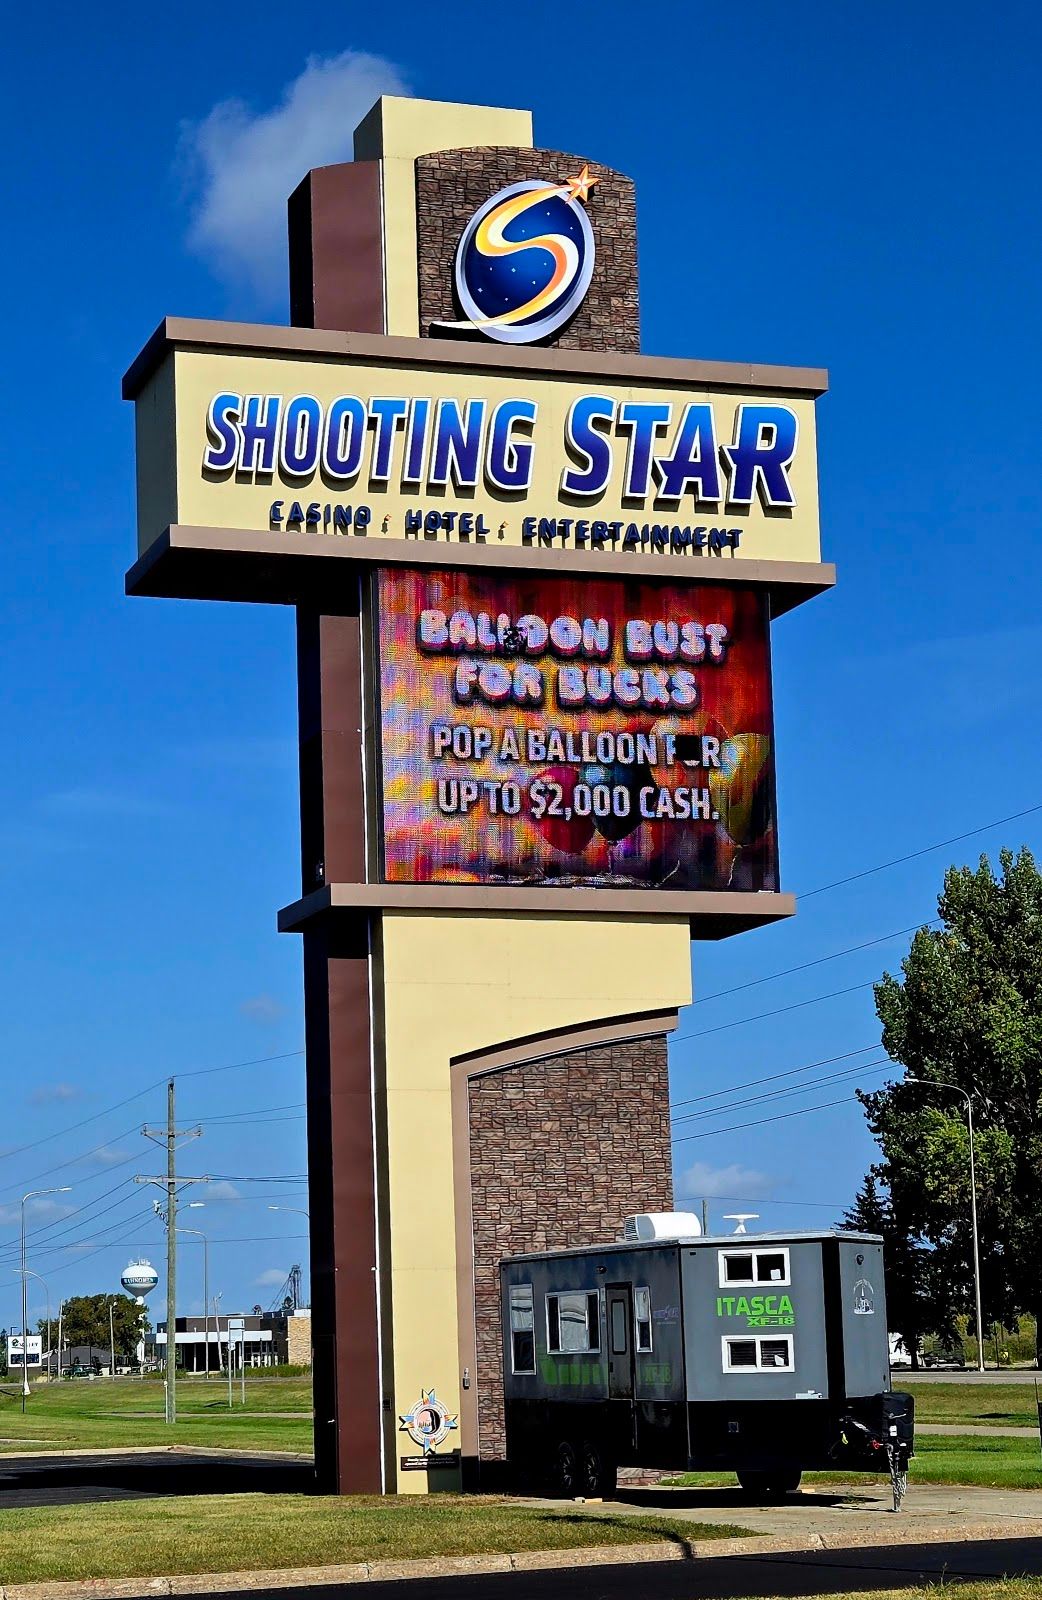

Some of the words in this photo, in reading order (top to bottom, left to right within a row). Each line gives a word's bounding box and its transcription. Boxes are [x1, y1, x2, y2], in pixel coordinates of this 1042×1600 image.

[203, 391, 538, 490] SHOOTING
[560, 393, 799, 508] STAR
[270, 500, 372, 530] CASINO
[405, 508, 491, 535] HOTEL
[522, 516, 744, 551] ENTERTAINMENT
[625, 618, 728, 658] BUST
[455, 658, 544, 700] FOR
[557, 664, 698, 706] BUCKS
[432, 724, 493, 759] POP
[500, 727, 520, 761] A
[528, 729, 658, 765] BALLOON
[661, 733, 721, 768] FR
[438, 779, 479, 812] UP
[484, 780, 521, 815] TO
[529, 778, 631, 821] $2,000
[639, 785, 720, 820] CASH.
[716, 1295, 794, 1317] ITASCA
[747, 1316, 796, 1326] XF-18
